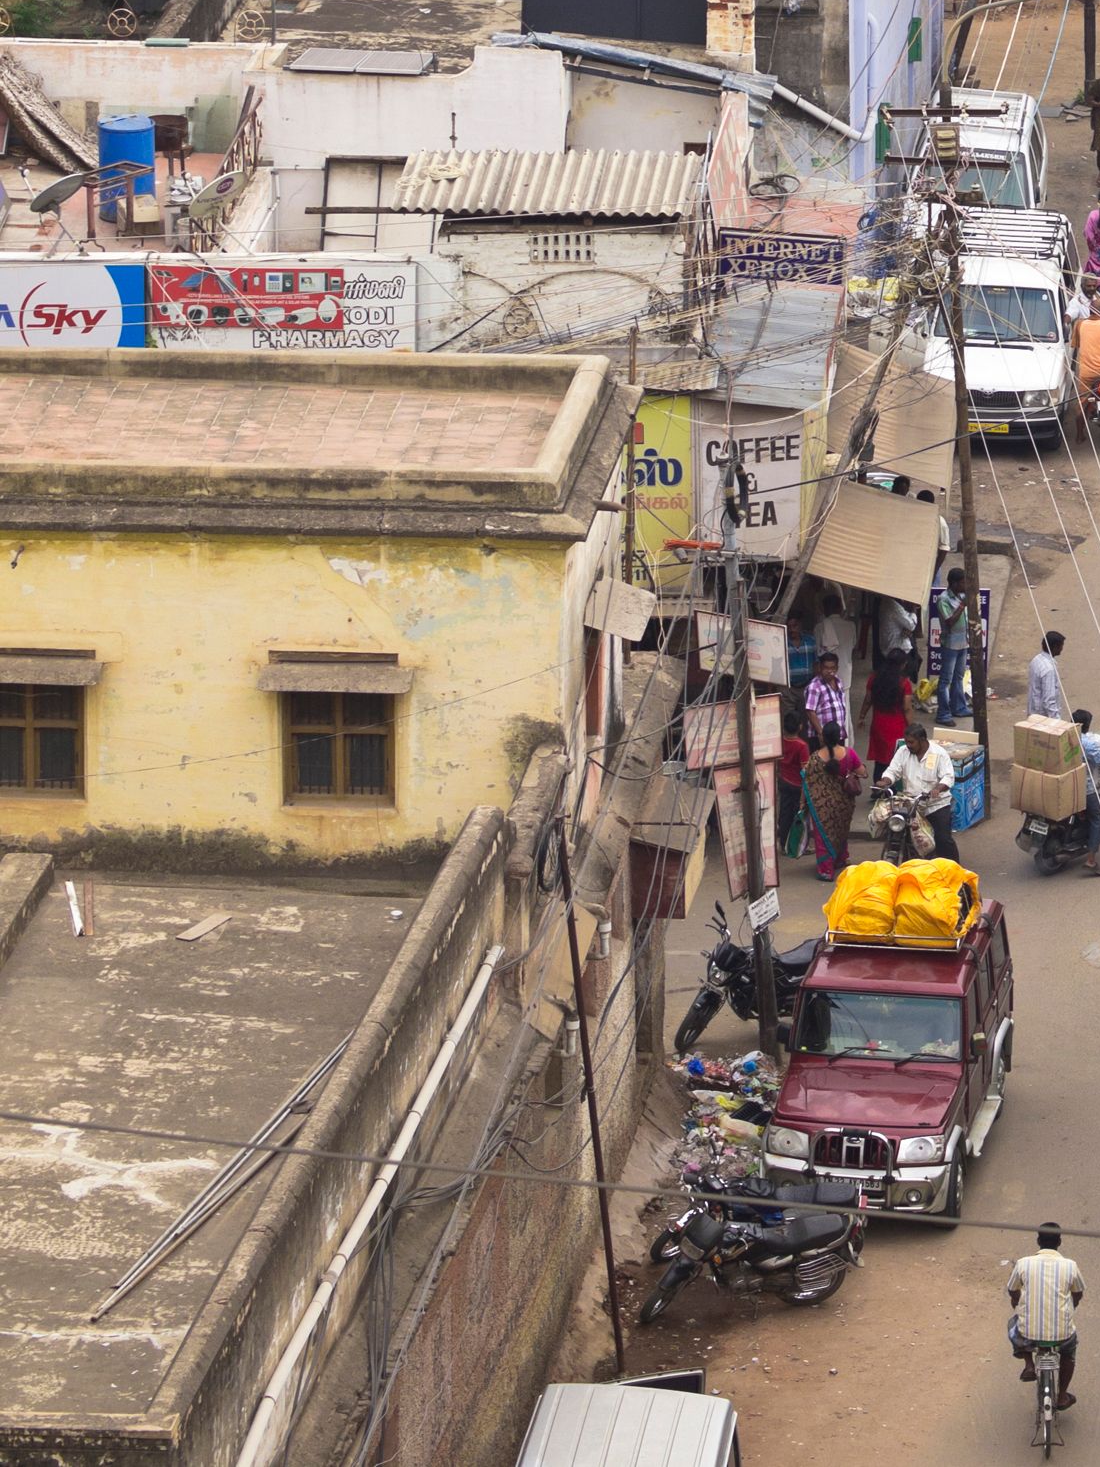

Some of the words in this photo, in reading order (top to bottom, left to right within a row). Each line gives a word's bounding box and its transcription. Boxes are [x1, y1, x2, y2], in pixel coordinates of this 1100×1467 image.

[725, 237, 841, 262] INTERNET
[726, 258, 811, 282] XEROX
[26, 304, 108, 335] Sky
[252, 329, 400, 349] PHARMACY
[706, 435, 800, 467] COFFEE
[747, 472, 758, 495] &
